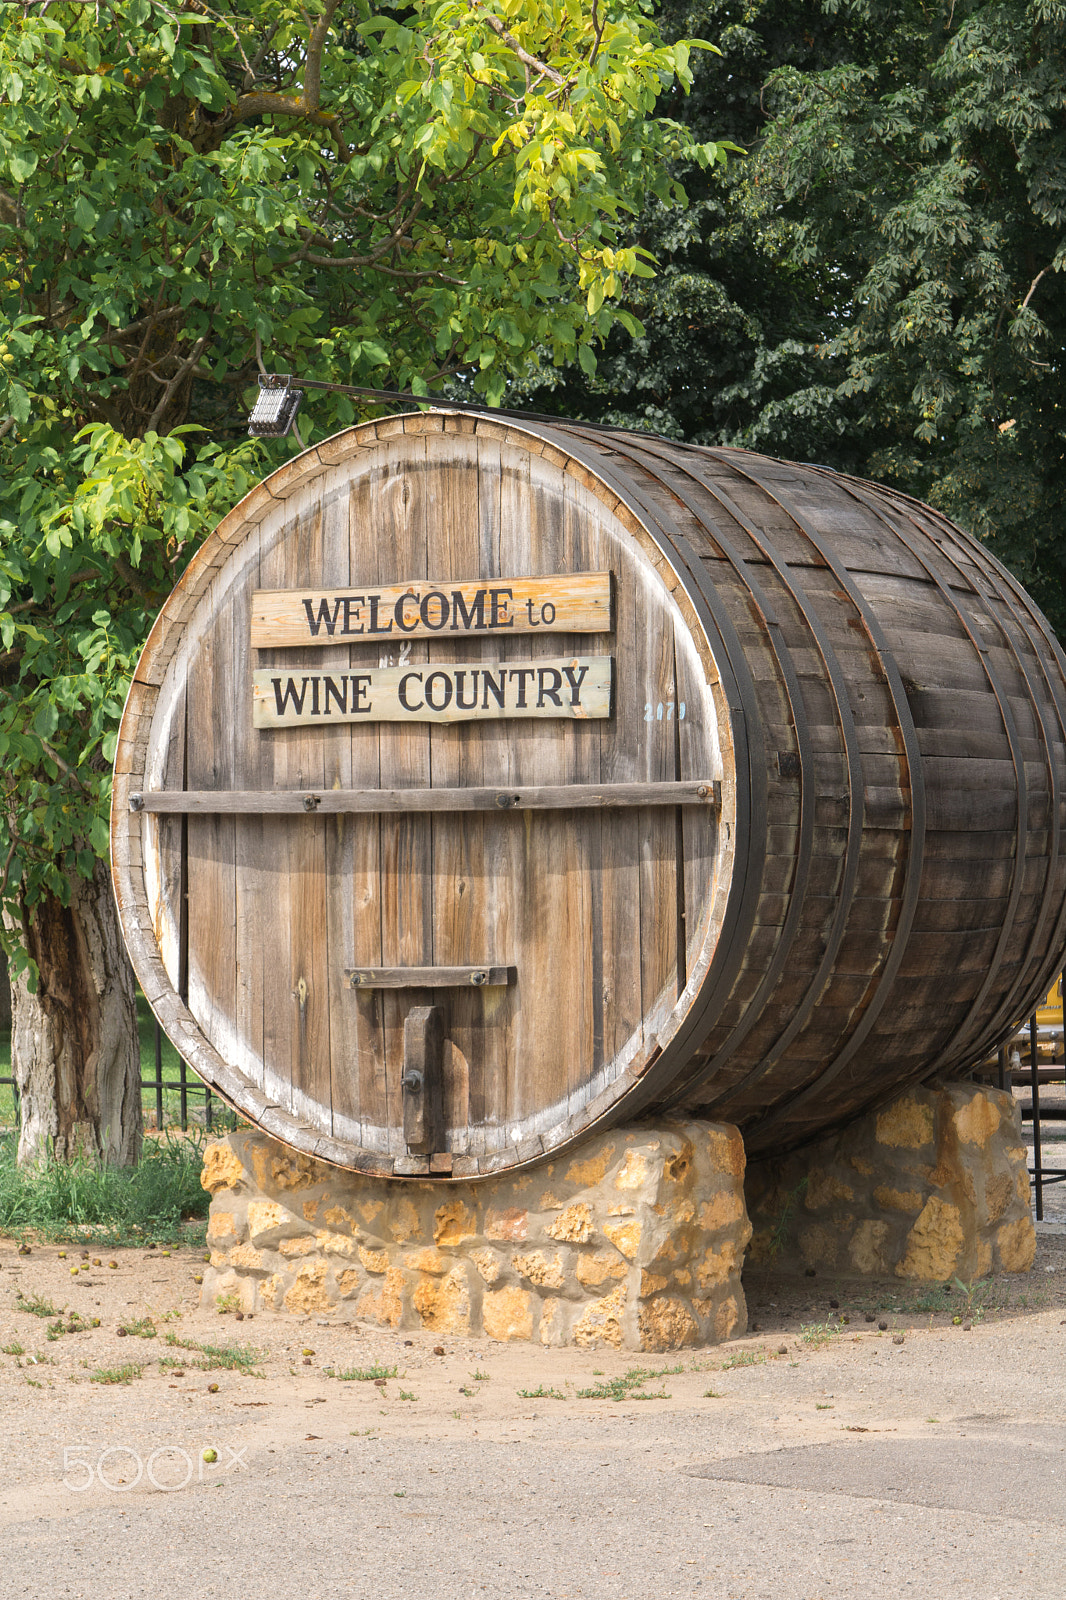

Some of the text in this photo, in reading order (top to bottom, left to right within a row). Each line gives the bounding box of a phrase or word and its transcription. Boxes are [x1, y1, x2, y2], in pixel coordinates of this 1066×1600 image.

[302, 588, 556, 636] WELCOME to
[271, 666, 589, 716] WINE COUNTRY
